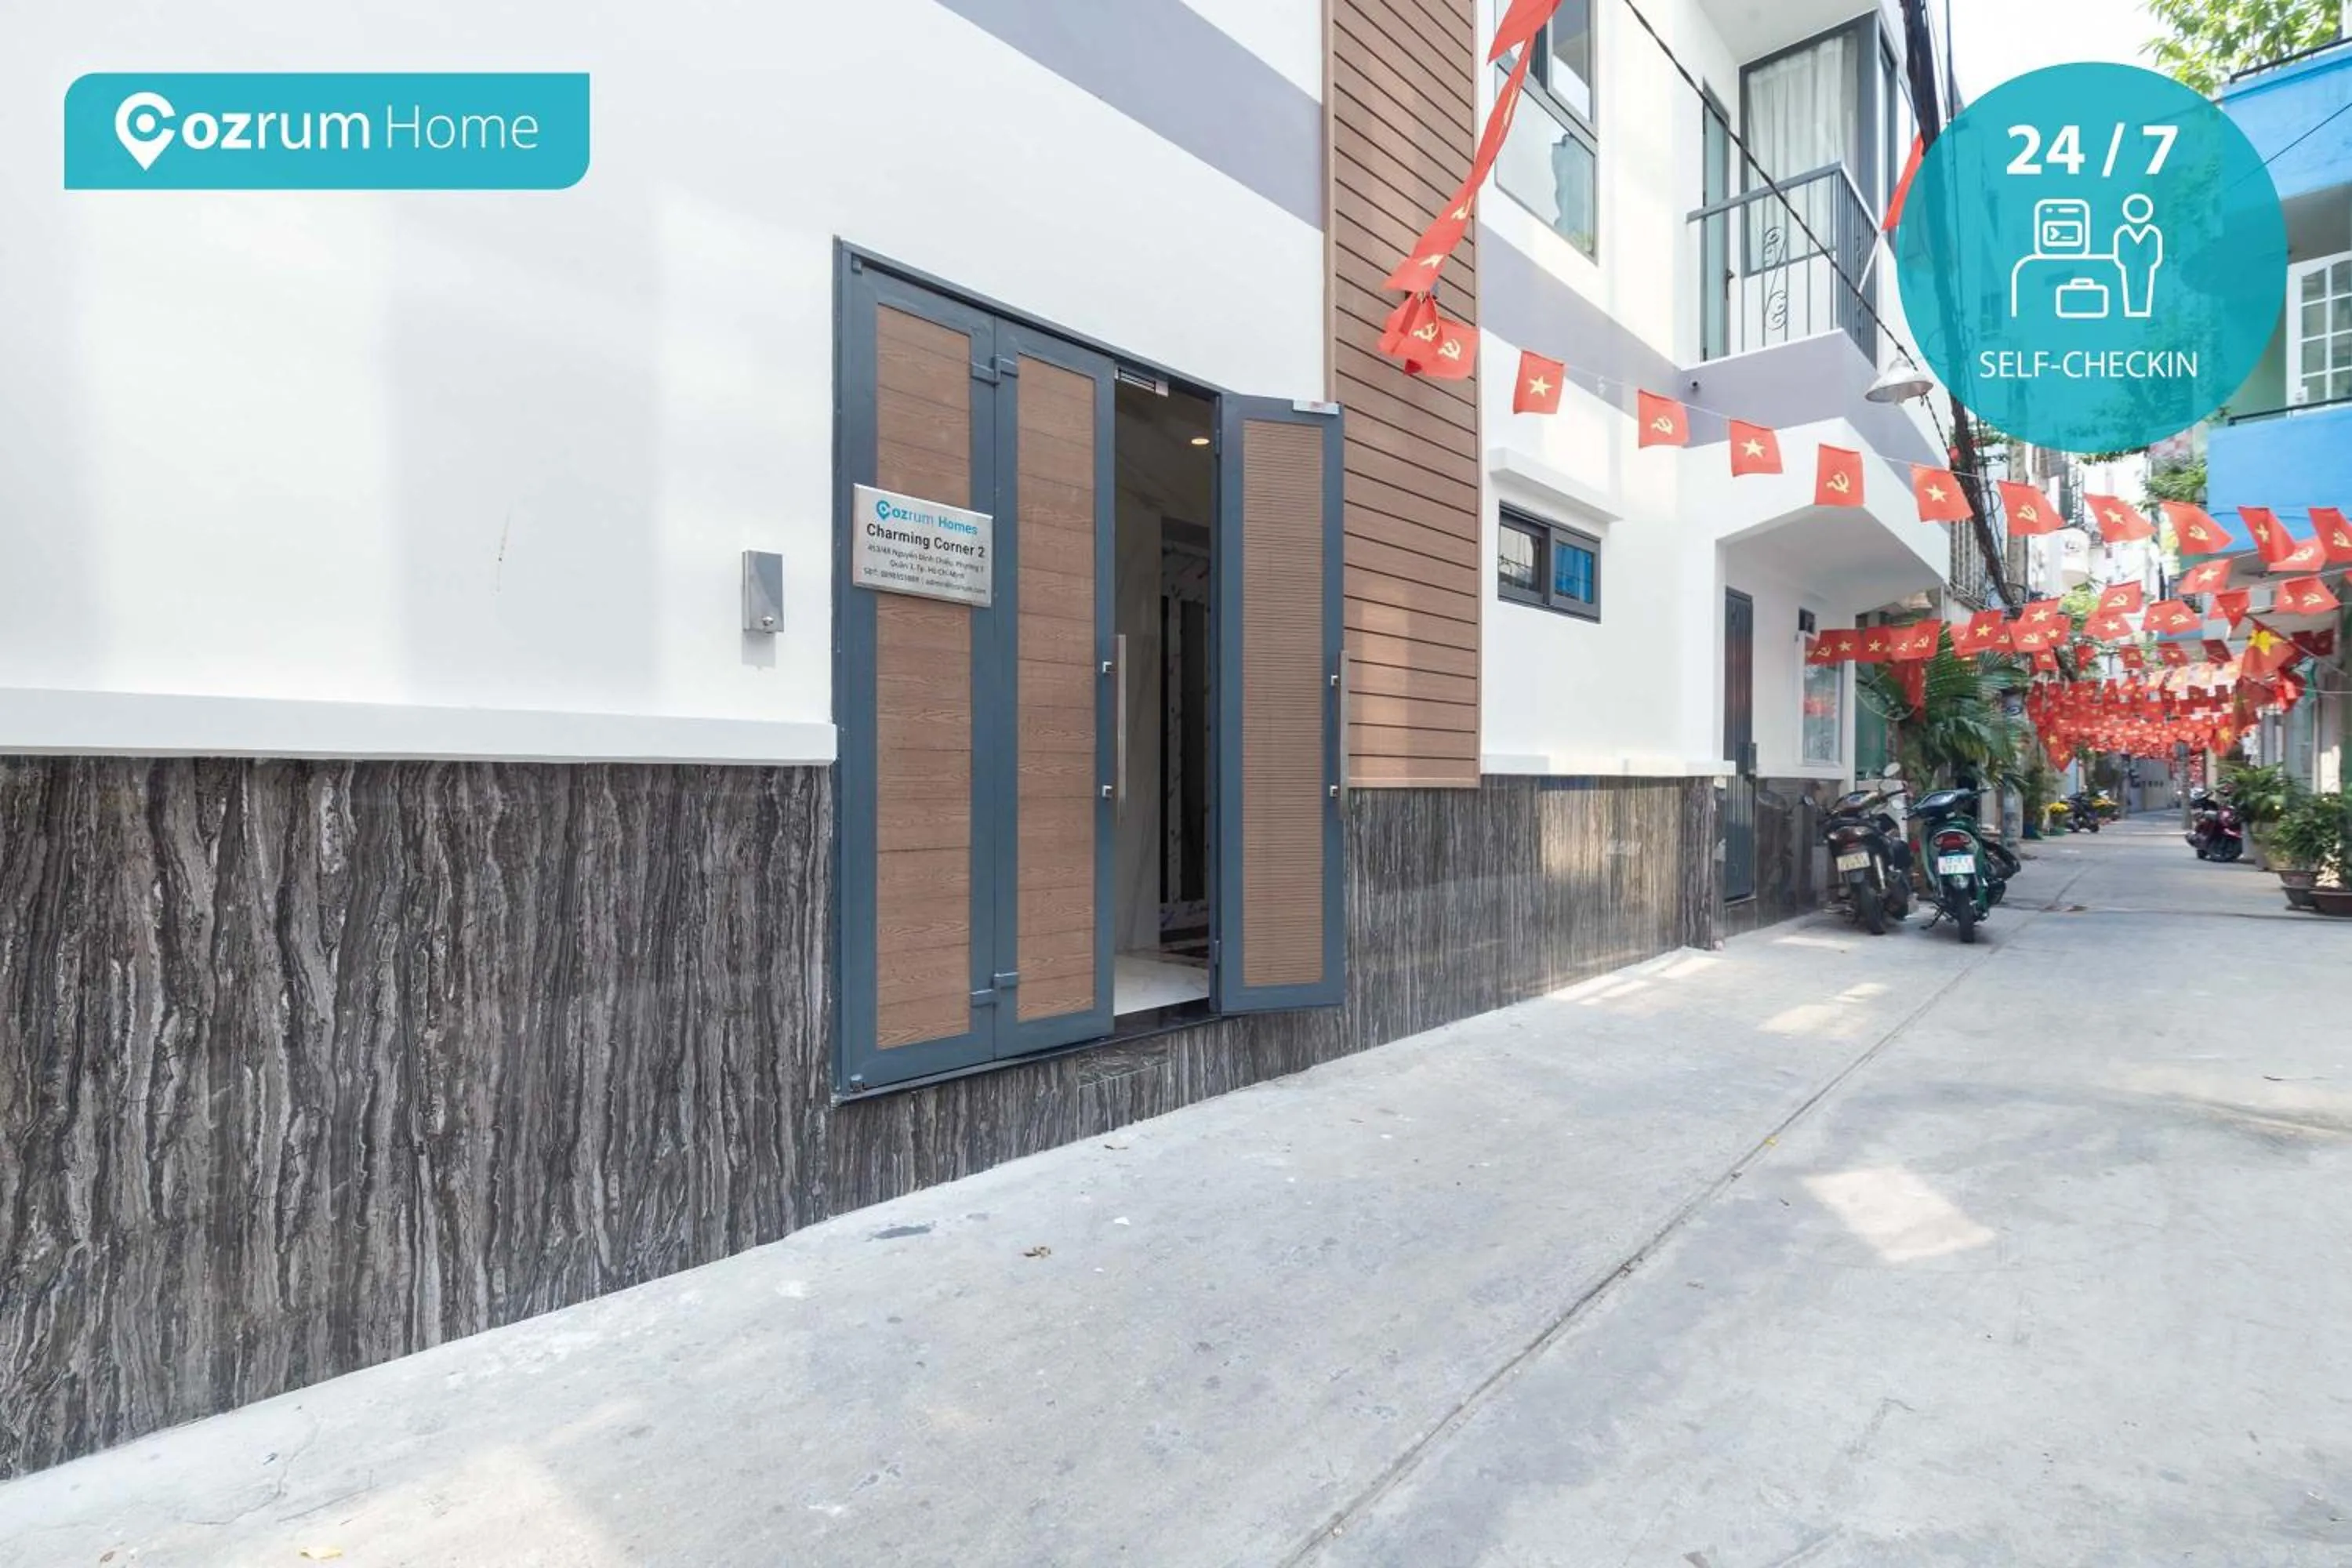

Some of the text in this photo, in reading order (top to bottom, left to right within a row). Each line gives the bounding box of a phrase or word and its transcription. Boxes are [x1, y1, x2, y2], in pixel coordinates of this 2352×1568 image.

[938, 515, 978, 535] Homes
[866, 523, 985, 557] Charming Corner 2
